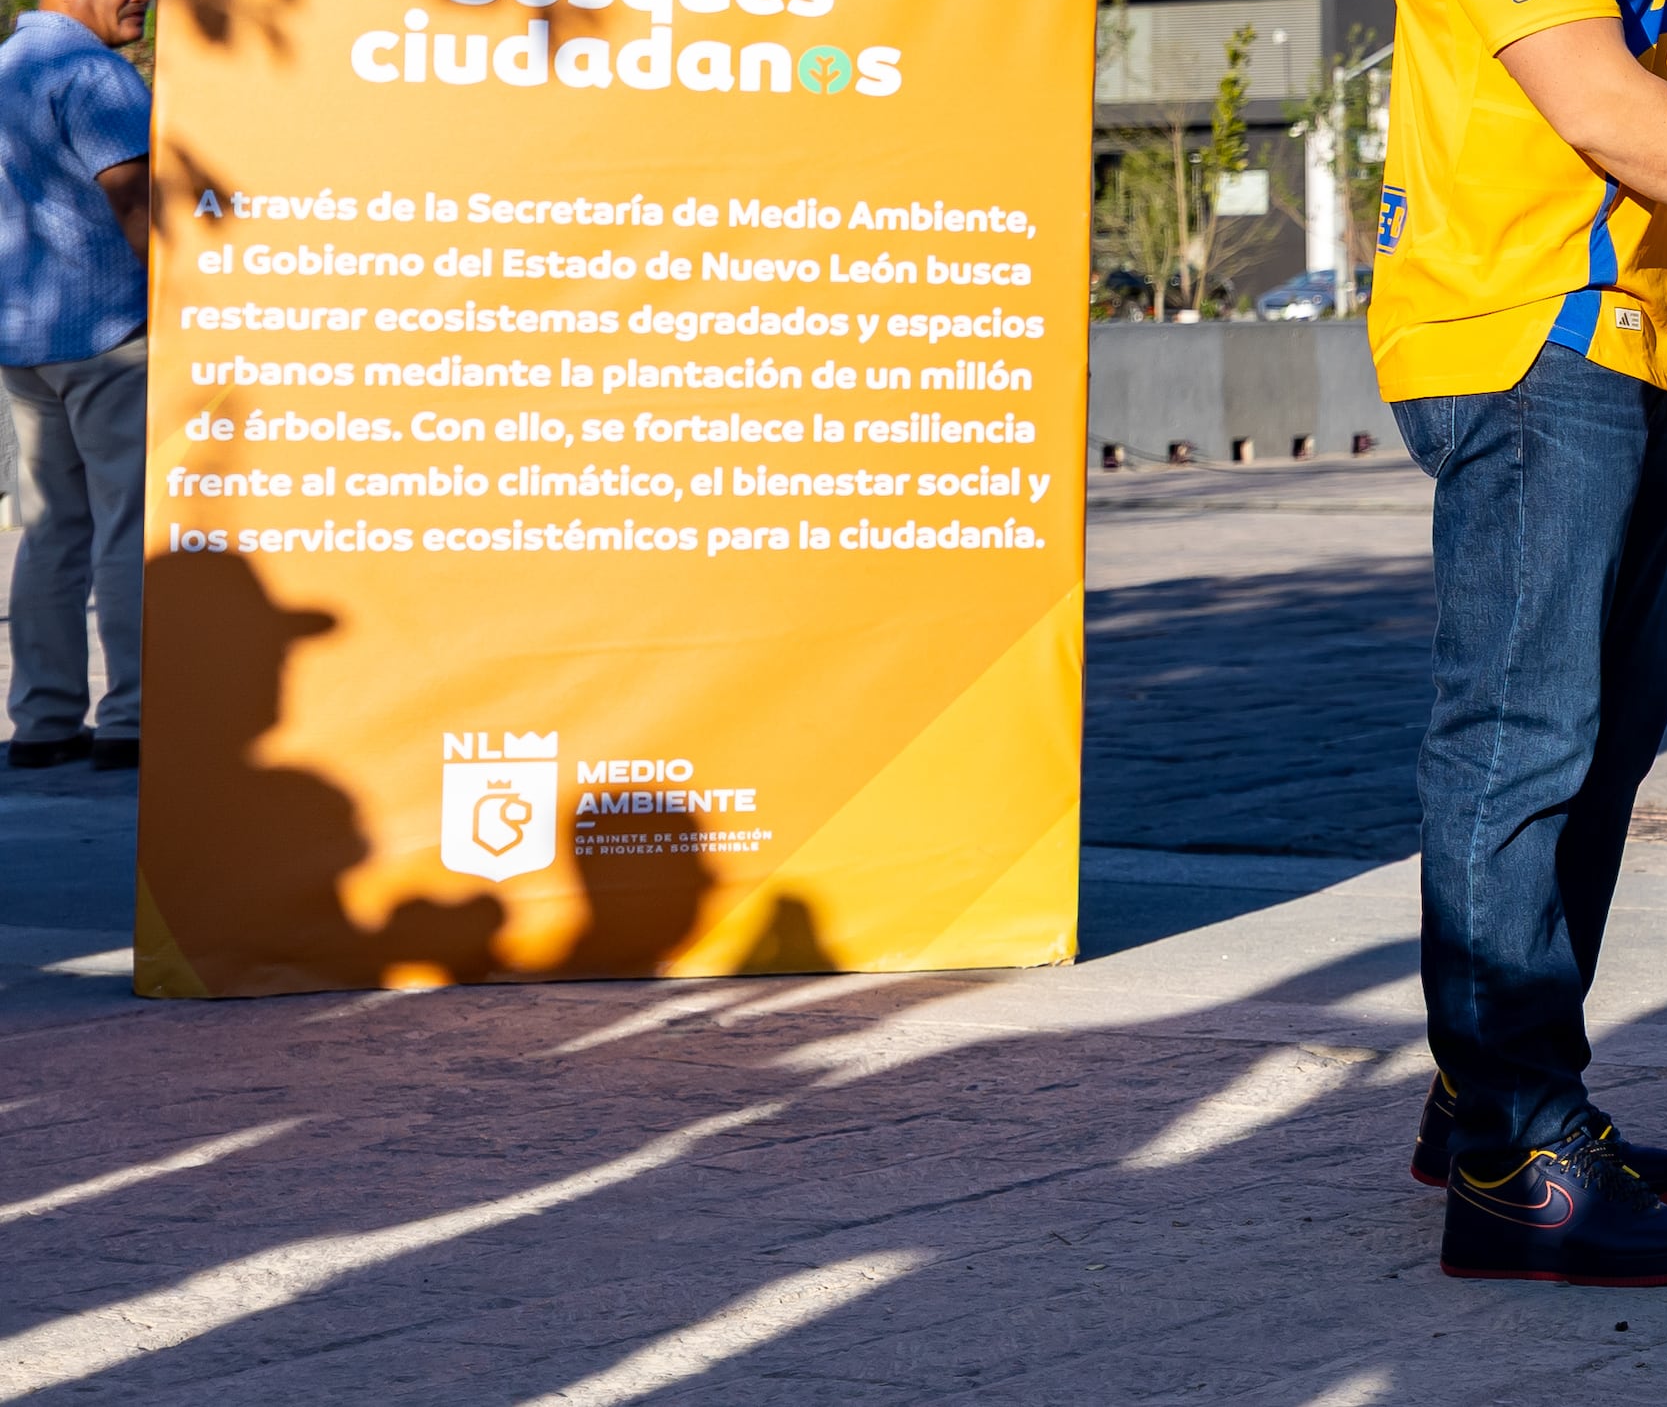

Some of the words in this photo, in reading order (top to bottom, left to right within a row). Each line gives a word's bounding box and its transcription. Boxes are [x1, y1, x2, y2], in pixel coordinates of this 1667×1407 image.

[351, 8, 903, 97] ciudadanos
[192, 190, 222, 218] A
[231, 188, 358, 220] través
[367, 191, 416, 222] de
[425, 192, 458, 222] la
[468, 193, 664, 226] Secretaría
[672, 197, 719, 227] de
[729, 198, 842, 229] Medio
[848, 200, 1036, 239] Ambiente,
[196, 244, 234, 274] el
[243, 244, 424, 276] Gobierno
[434, 247, 492, 277] del
[503, 249, 637, 280] Estado
[645, 250, 692, 280] de
[702, 252, 820, 282] Nuevo
[830, 252, 917, 284] León
[927, 255, 1032, 286] busca
[180, 302, 368, 331] restaurar
[375, 300, 619, 333] ecosistemas
[628, 304, 849, 341] degradados
[857, 314, 880, 344] y
[887, 307, 1045, 344] espacios
[191, 355, 354, 386] urbanos
[364, 355, 552, 387] mediante
[561, 358, 594, 387] la
[603, 357, 802, 394] plantación
[811, 360, 857, 389] de
[866, 367, 911, 389] un
[920, 359, 1033, 391] millón
[184, 411, 234, 441] de
[244, 409, 403, 441] árboles.
[411, 411, 485, 441] Con
[495, 412, 574, 448] ello,
[582, 419, 625, 442] se
[634, 412, 804, 442] fortalece
[814, 413, 845, 443] la
[854, 412, 1036, 444] resiliencia
[165, 466, 293, 497] frente
[301, 466, 336, 496] al
[345, 464, 489, 496] cambio
[498, 464, 683, 502] climático,
[690, 467, 723, 496] el
[733, 465, 911, 496] bienestar
[917, 465, 1021, 496] social
[1028, 474, 1051, 503] y
[168, 522, 228, 552] los
[238, 520, 413, 553] servicios
[423, 519, 698, 551] ecosistémicos
[707, 527, 790, 557] para
[799, 520, 831, 550] la
[839, 517, 1046, 550] ciudadanía.
[443, 732, 501, 759] NL
[577, 758, 695, 785] MEDIO
[575, 788, 757, 816] AMBIENTE
[575, 832, 648, 844] GABINETE
[653, 832, 673, 844] DE
[678, 827, 773, 841] GENERACIÓN
[575, 845, 593, 857] DE
[600, 844, 664, 855] RIQUEZA
[671, 841, 760, 853] SOSTENIBLE
